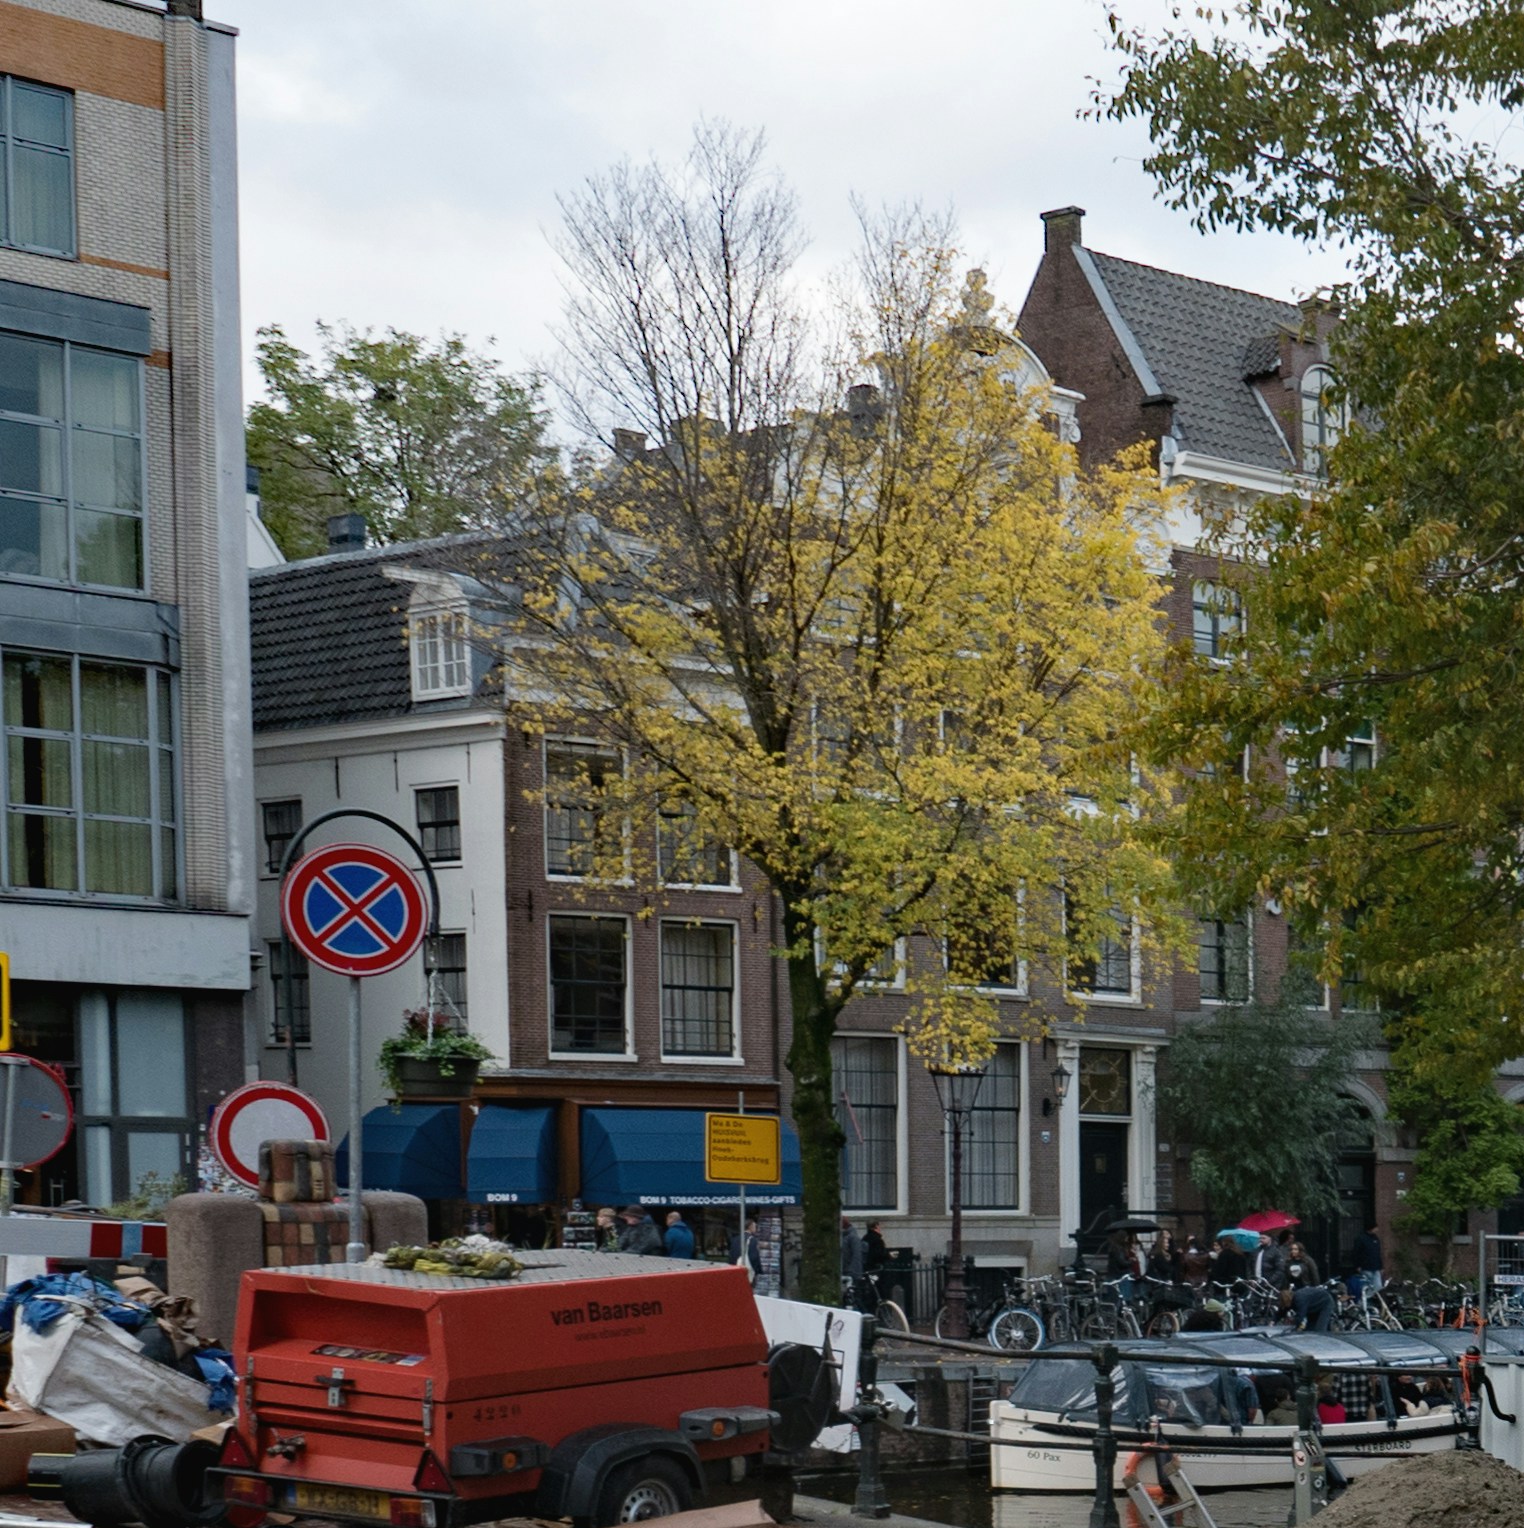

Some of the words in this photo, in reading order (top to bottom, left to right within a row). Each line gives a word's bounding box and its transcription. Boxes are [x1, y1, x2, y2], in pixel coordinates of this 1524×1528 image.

[550, 1308, 585, 1326] van
[587, 1300, 663, 1322] Baarsen
[1355, 1440, 1412, 1453] STARBOARD
[1027, 1450, 1041, 1460] 60
[1043, 1451, 1061, 1463] Pax
